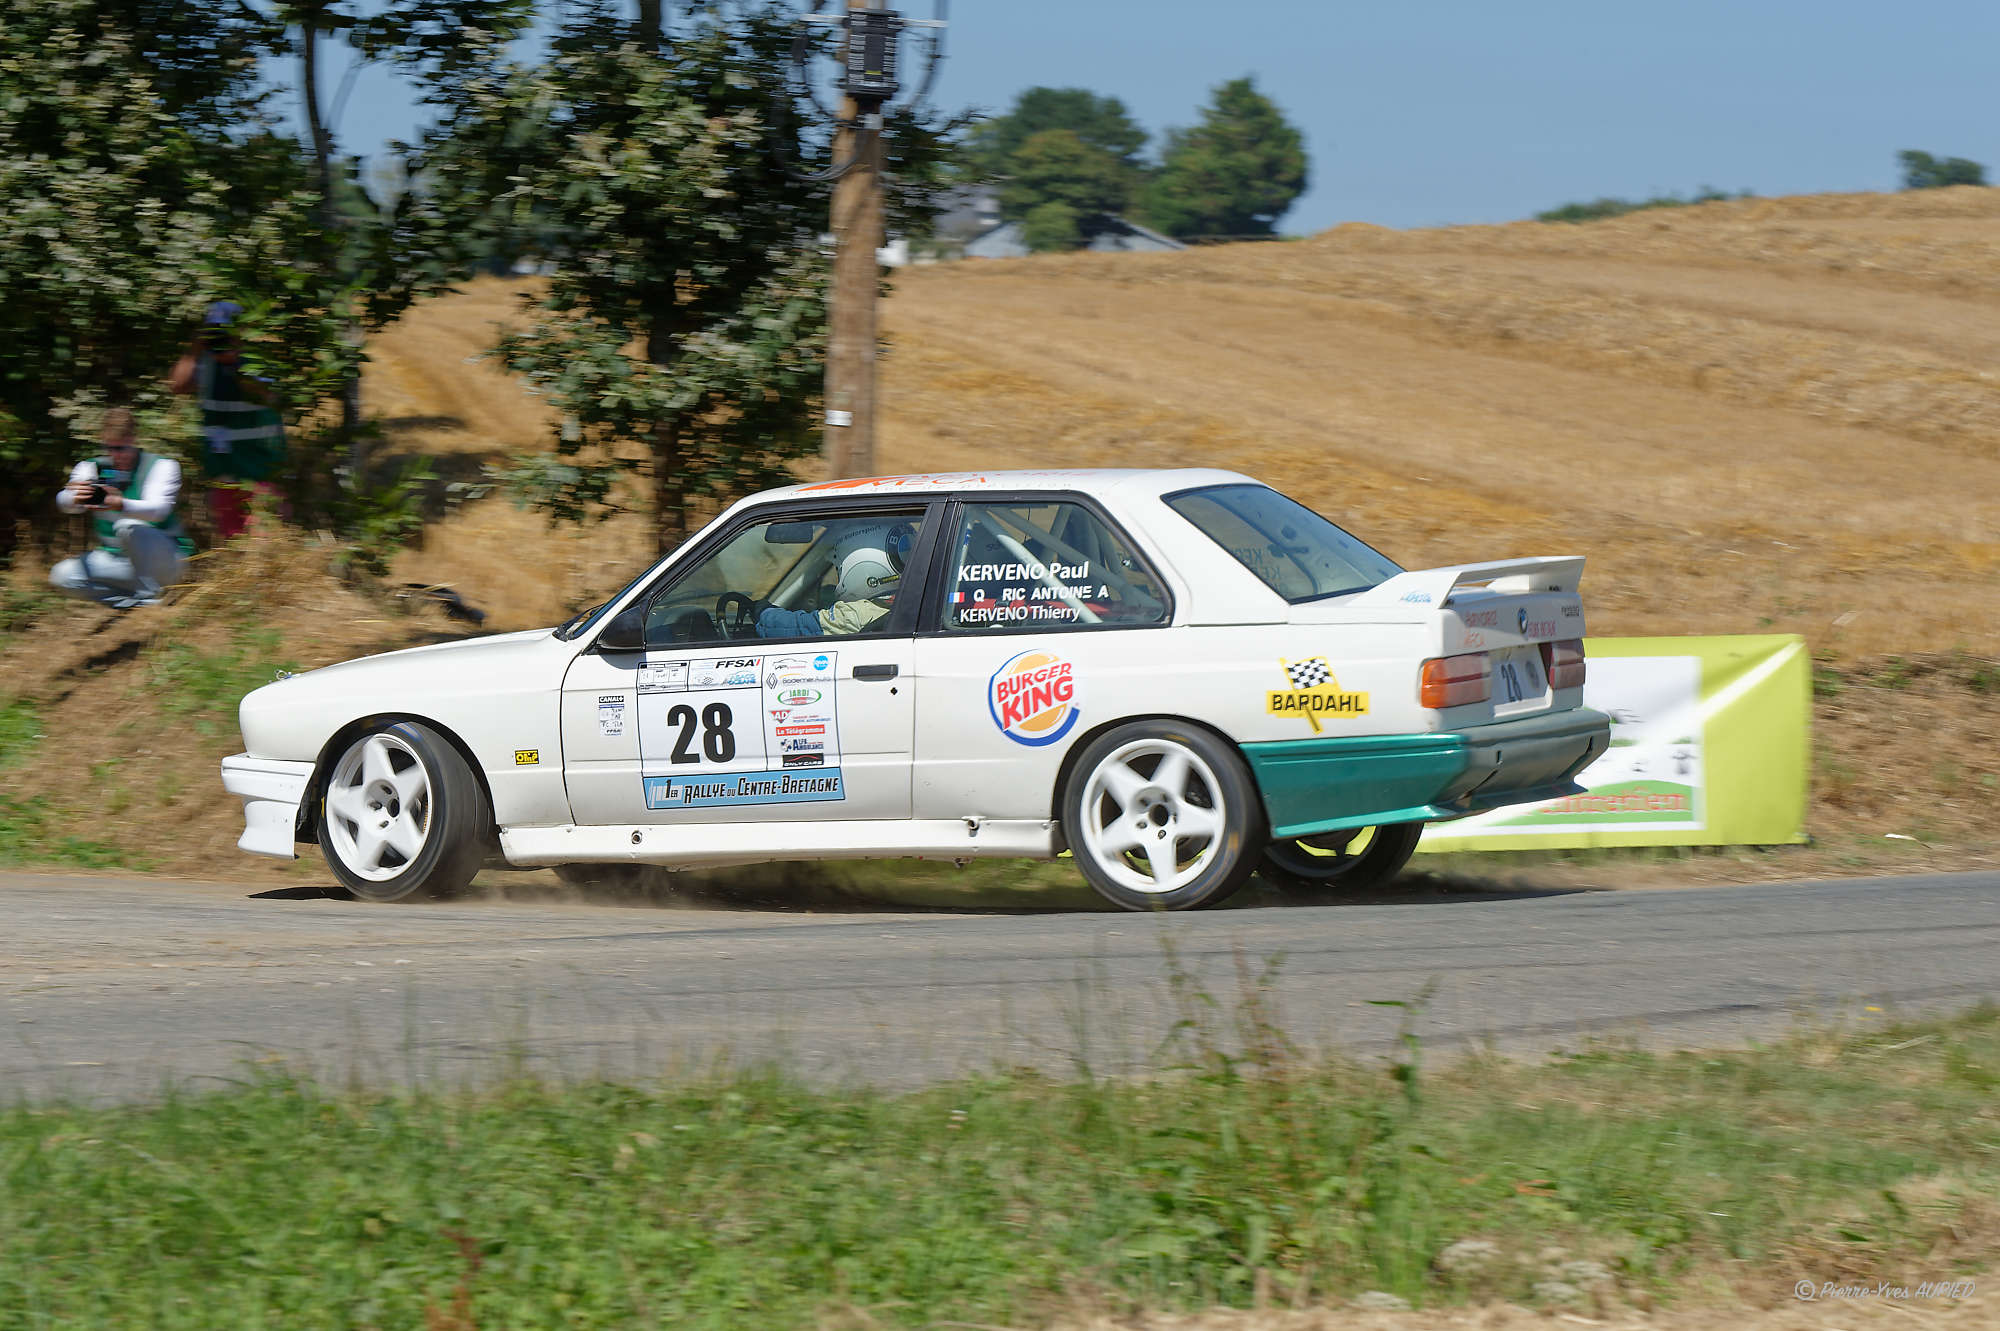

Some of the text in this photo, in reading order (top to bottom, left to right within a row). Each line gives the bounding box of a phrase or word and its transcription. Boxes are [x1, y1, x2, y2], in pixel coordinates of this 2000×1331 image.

[958, 561, 1089, 581] KERVENO Paul
[1031, 585, 1092, 600] ANTOINE
[1098, 584, 1109, 598] A
[960, 605, 1081, 622] KERVENO Thierry
[716, 659, 754, 668] FFSA
[997, 663, 1072, 703] BURGER
[1002, 675, 1073, 730] KING
[1272, 694, 1364, 711] BARDAHL
[776, 711, 788, 719] AD
[667, 702, 736, 764] 28
[684, 783, 725, 803] RALLYE
[738, 775, 839, 796] CENTRE-BRETAGNE
